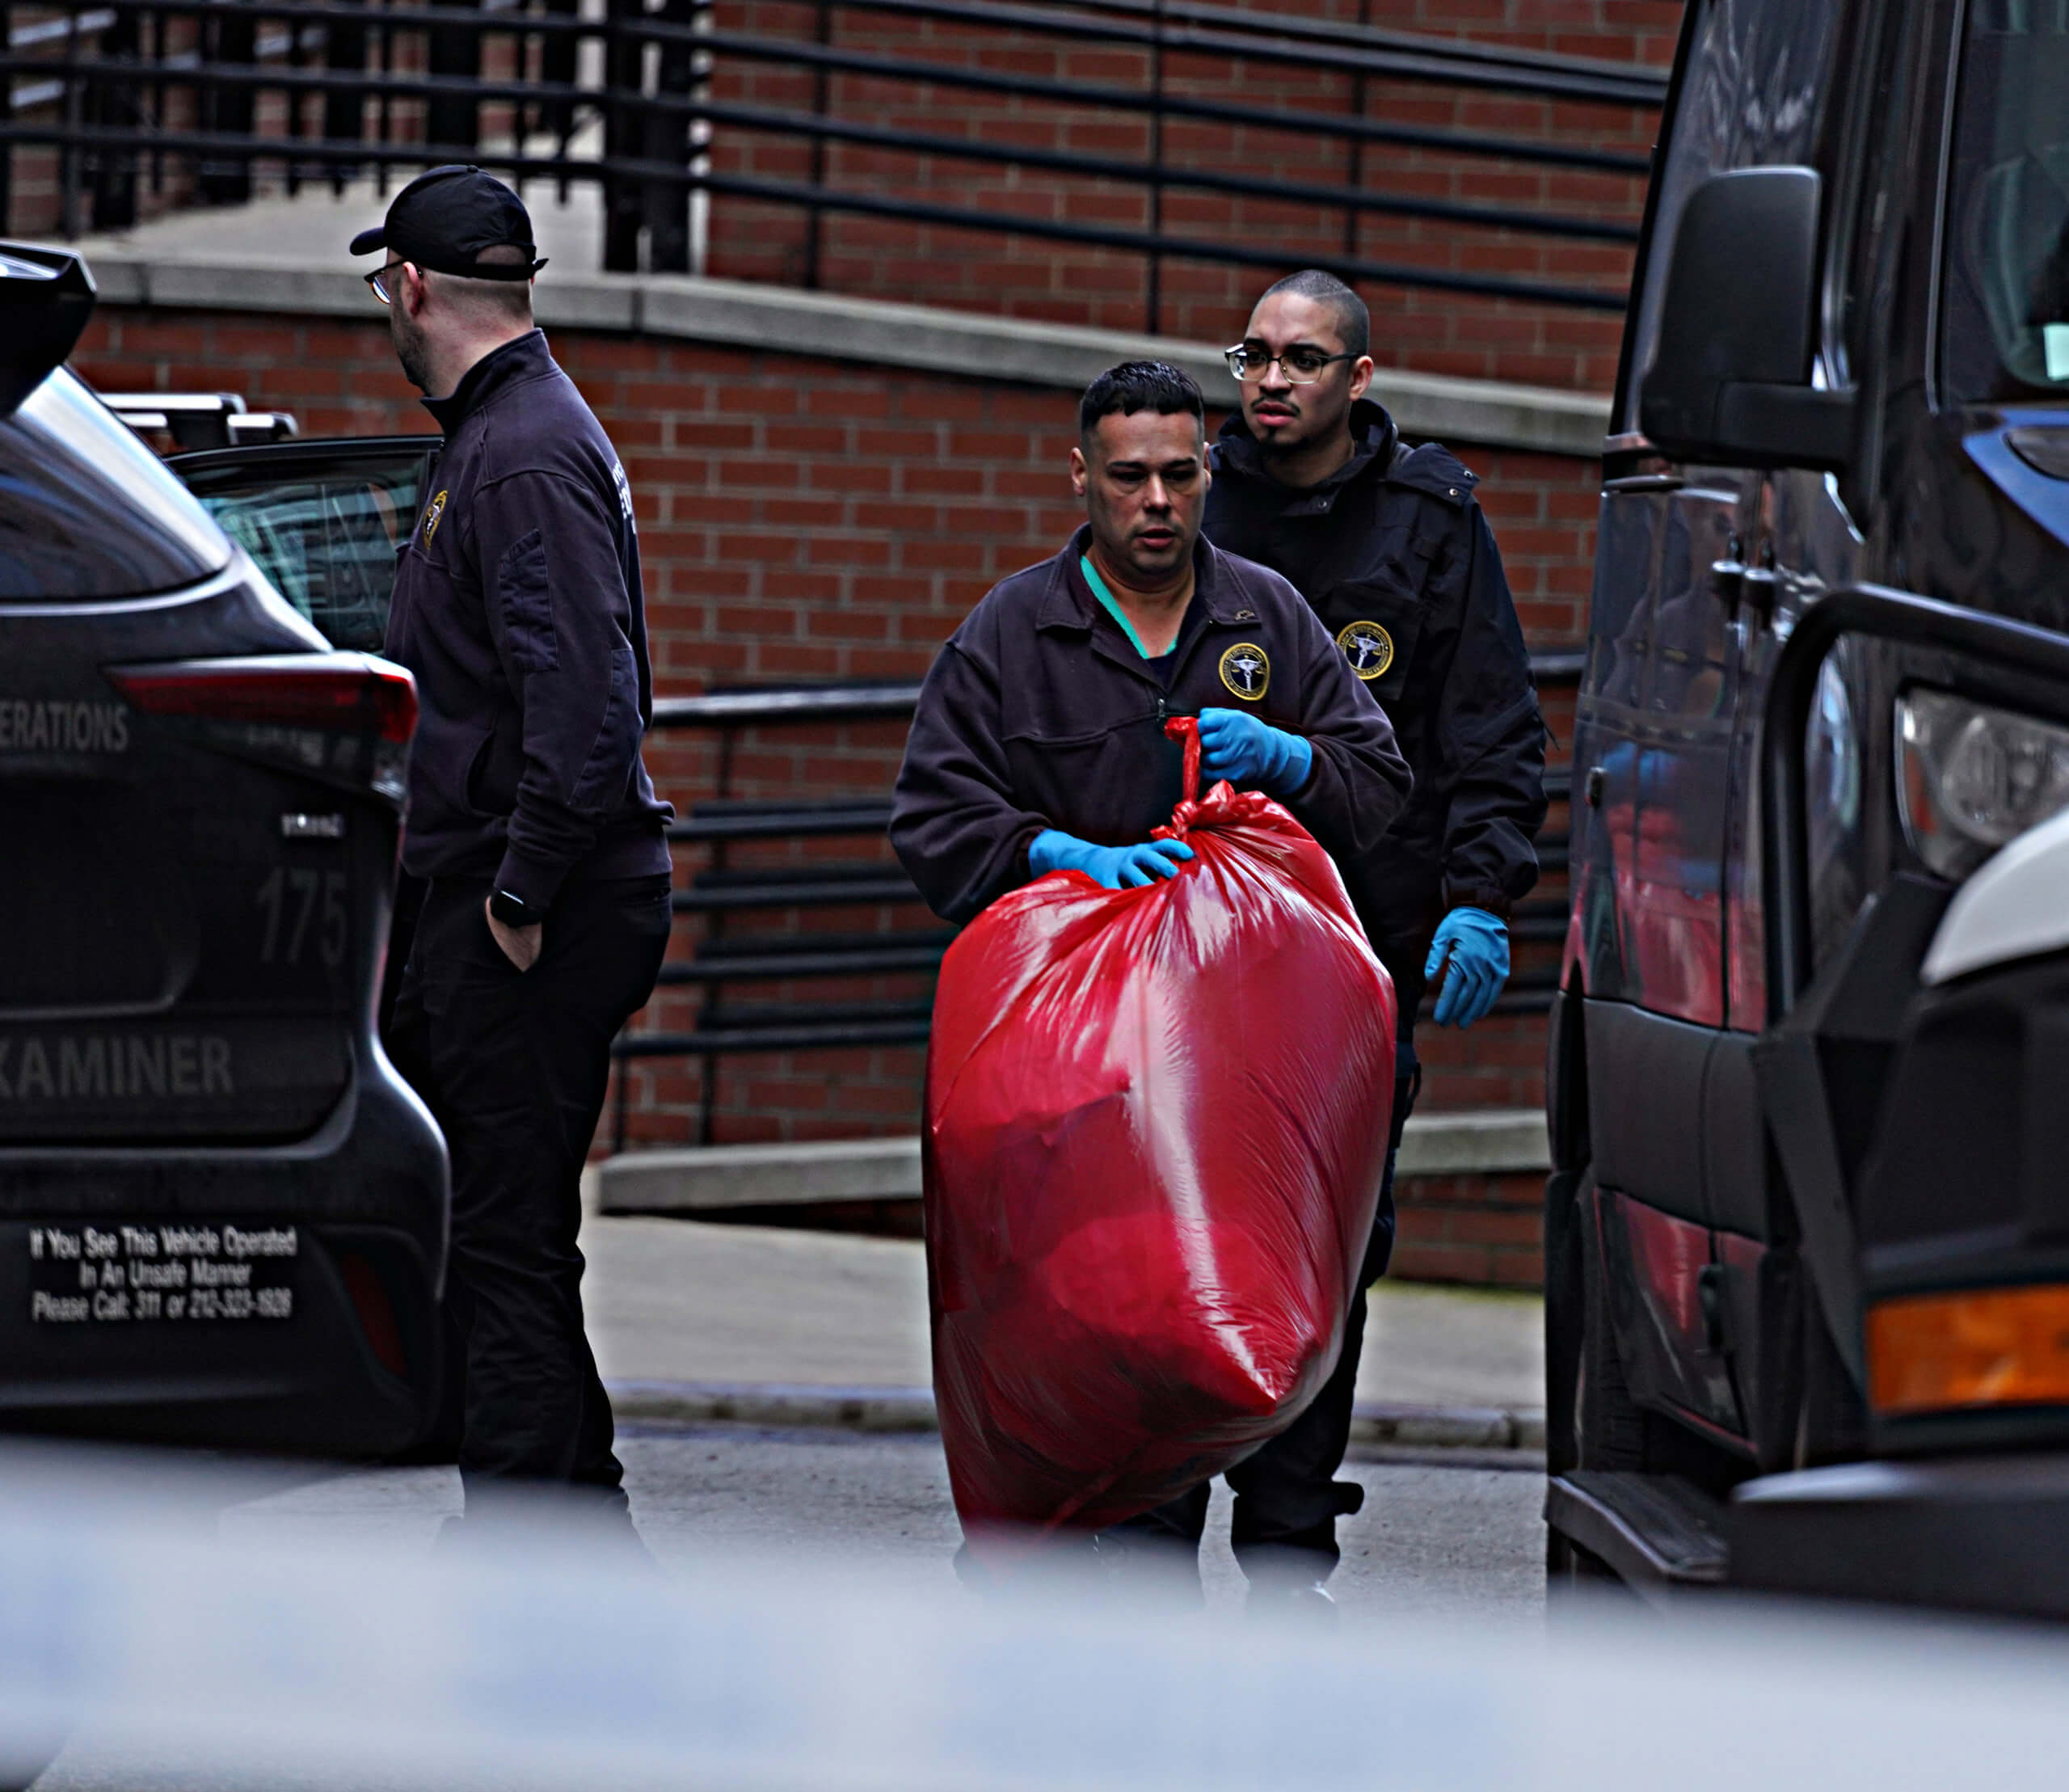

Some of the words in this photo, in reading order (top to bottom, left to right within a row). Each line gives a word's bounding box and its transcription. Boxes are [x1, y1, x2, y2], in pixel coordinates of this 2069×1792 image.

[0, 700, 130, 753] ERATIONS
[256, 866, 348, 967] 175
[46, 1228, 80, 1259] You
[83, 1226, 118, 1259] See
[120, 1226, 158, 1258] This
[160, 1226, 220, 1257] Vehicle
[223, 1225, 297, 1259] Operated
[80, 1260, 97, 1288] In
[100, 1259, 124, 1288] An
[129, 1259, 187, 1288] Unsafe
[191, 1257, 252, 1287] Manner
[32, 1291, 89, 1322] Please
[166, 1295, 187, 1318] or
